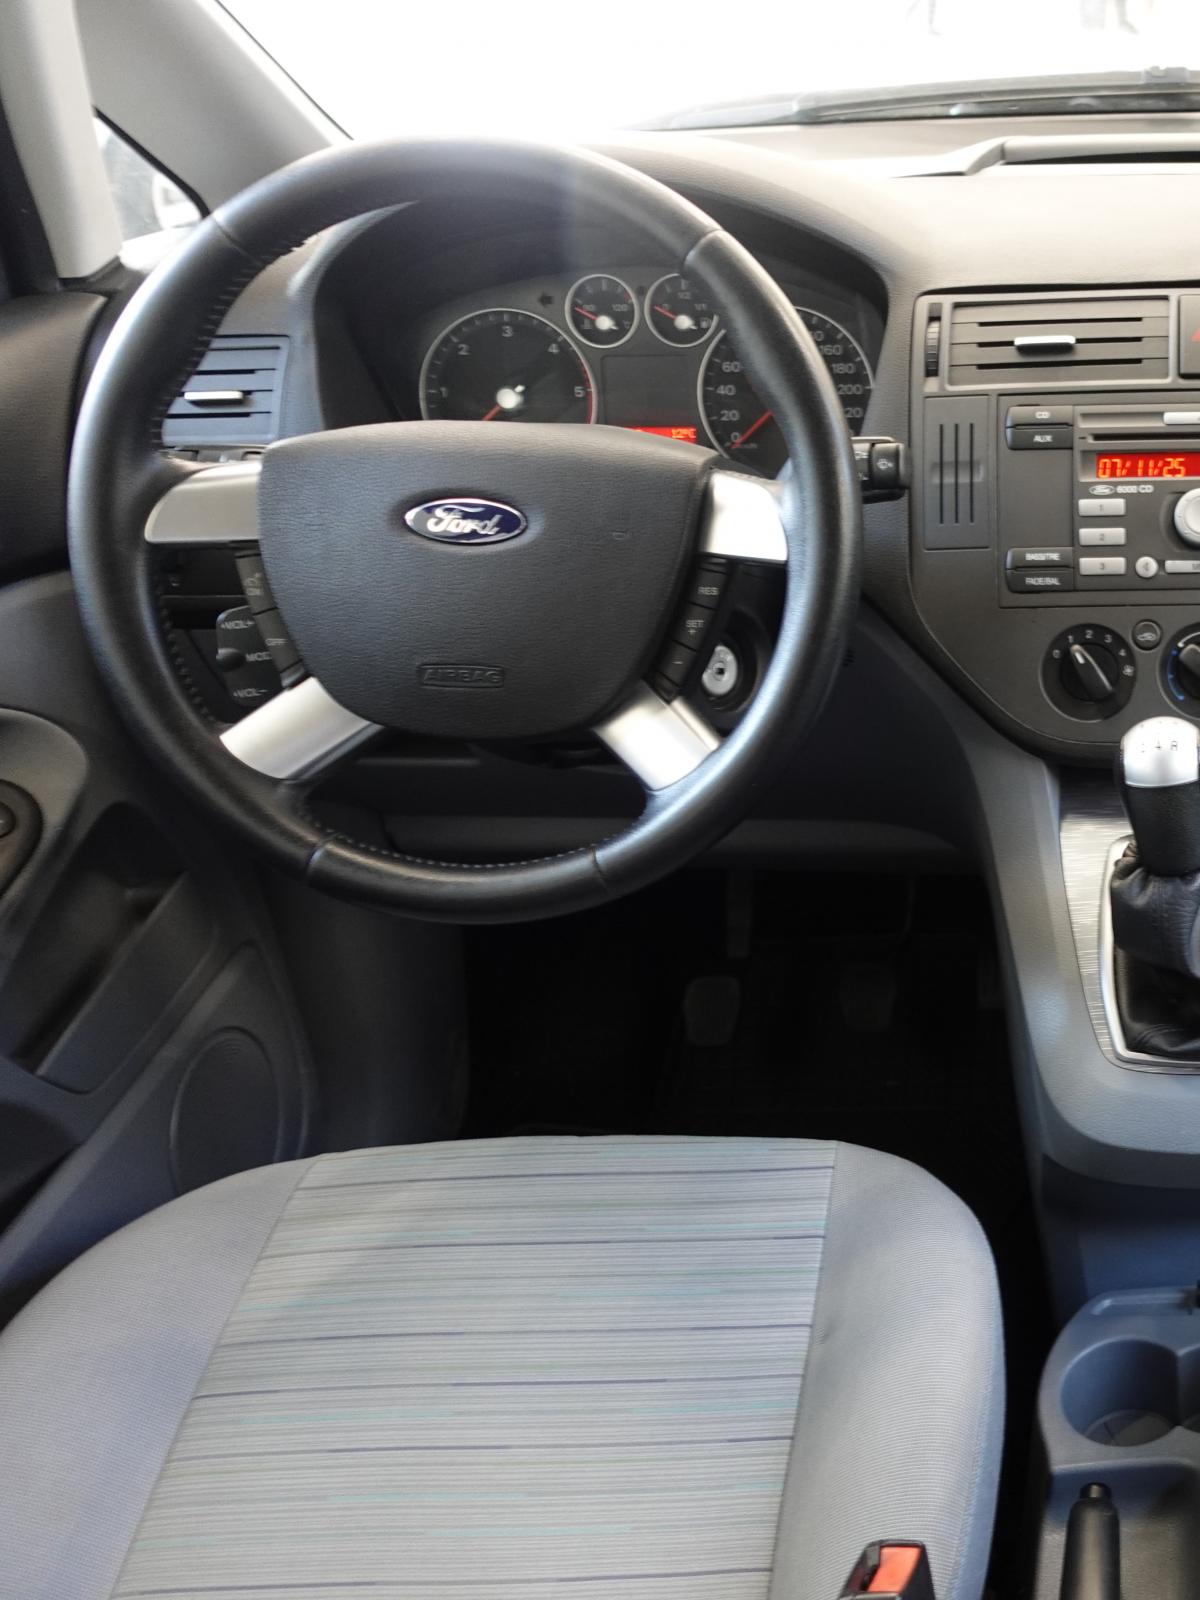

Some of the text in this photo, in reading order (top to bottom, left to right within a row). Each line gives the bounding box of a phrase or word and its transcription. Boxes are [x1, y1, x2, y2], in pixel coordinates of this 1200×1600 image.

[502, 326, 514, 338] 3
[457, 344, 470, 355] 2
[547, 343, 559, 354] 4
[721, 361, 741, 373] 60
[831, 363, 855, 374] 180
[574, 386, 585, 398] 5
[716, 384, 737, 396] 40
[837, 384, 863, 395] 200
[720, 409, 740, 421] 20
[844, 407, 864, 419] 20
[1033, 434, 1053, 443] AUX
[1097, 457, 1187, 479] 07/11/25
[427, 504, 503, 535] Ford
[1067, 634, 1074, 644] 1
[1085, 629, 1094, 639] 2
[1104, 634, 1113, 643] 3
